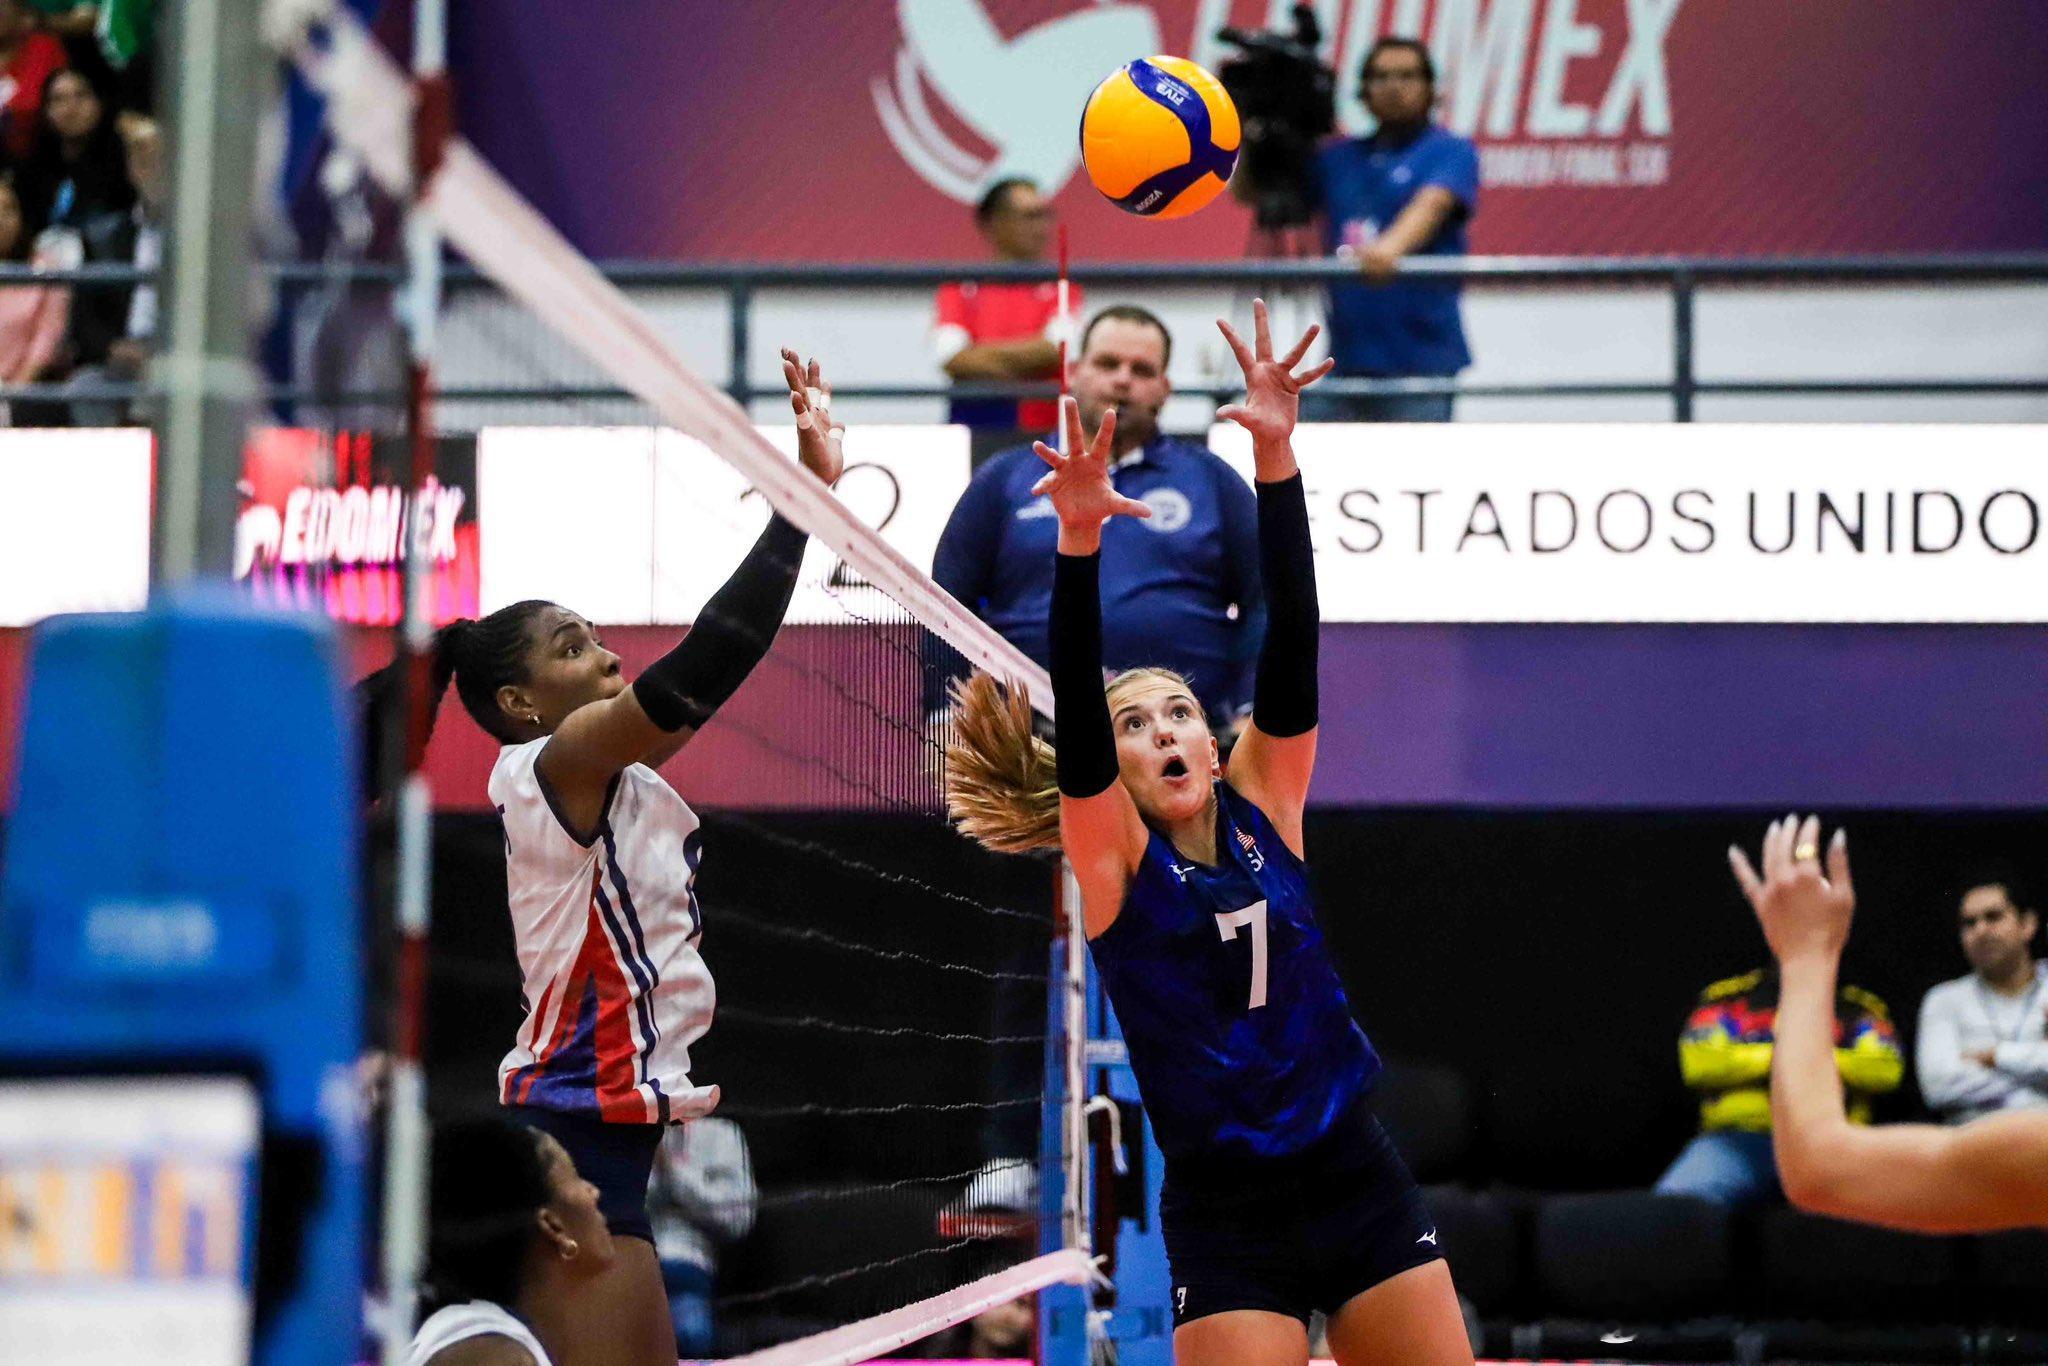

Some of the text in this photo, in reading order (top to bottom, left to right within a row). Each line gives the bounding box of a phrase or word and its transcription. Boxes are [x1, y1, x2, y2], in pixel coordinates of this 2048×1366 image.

[1155, 82, 1185, 106] FIVB
[1748, 489, 2041, 554] UNIDO
[1214, 899, 1268, 1010] 7
